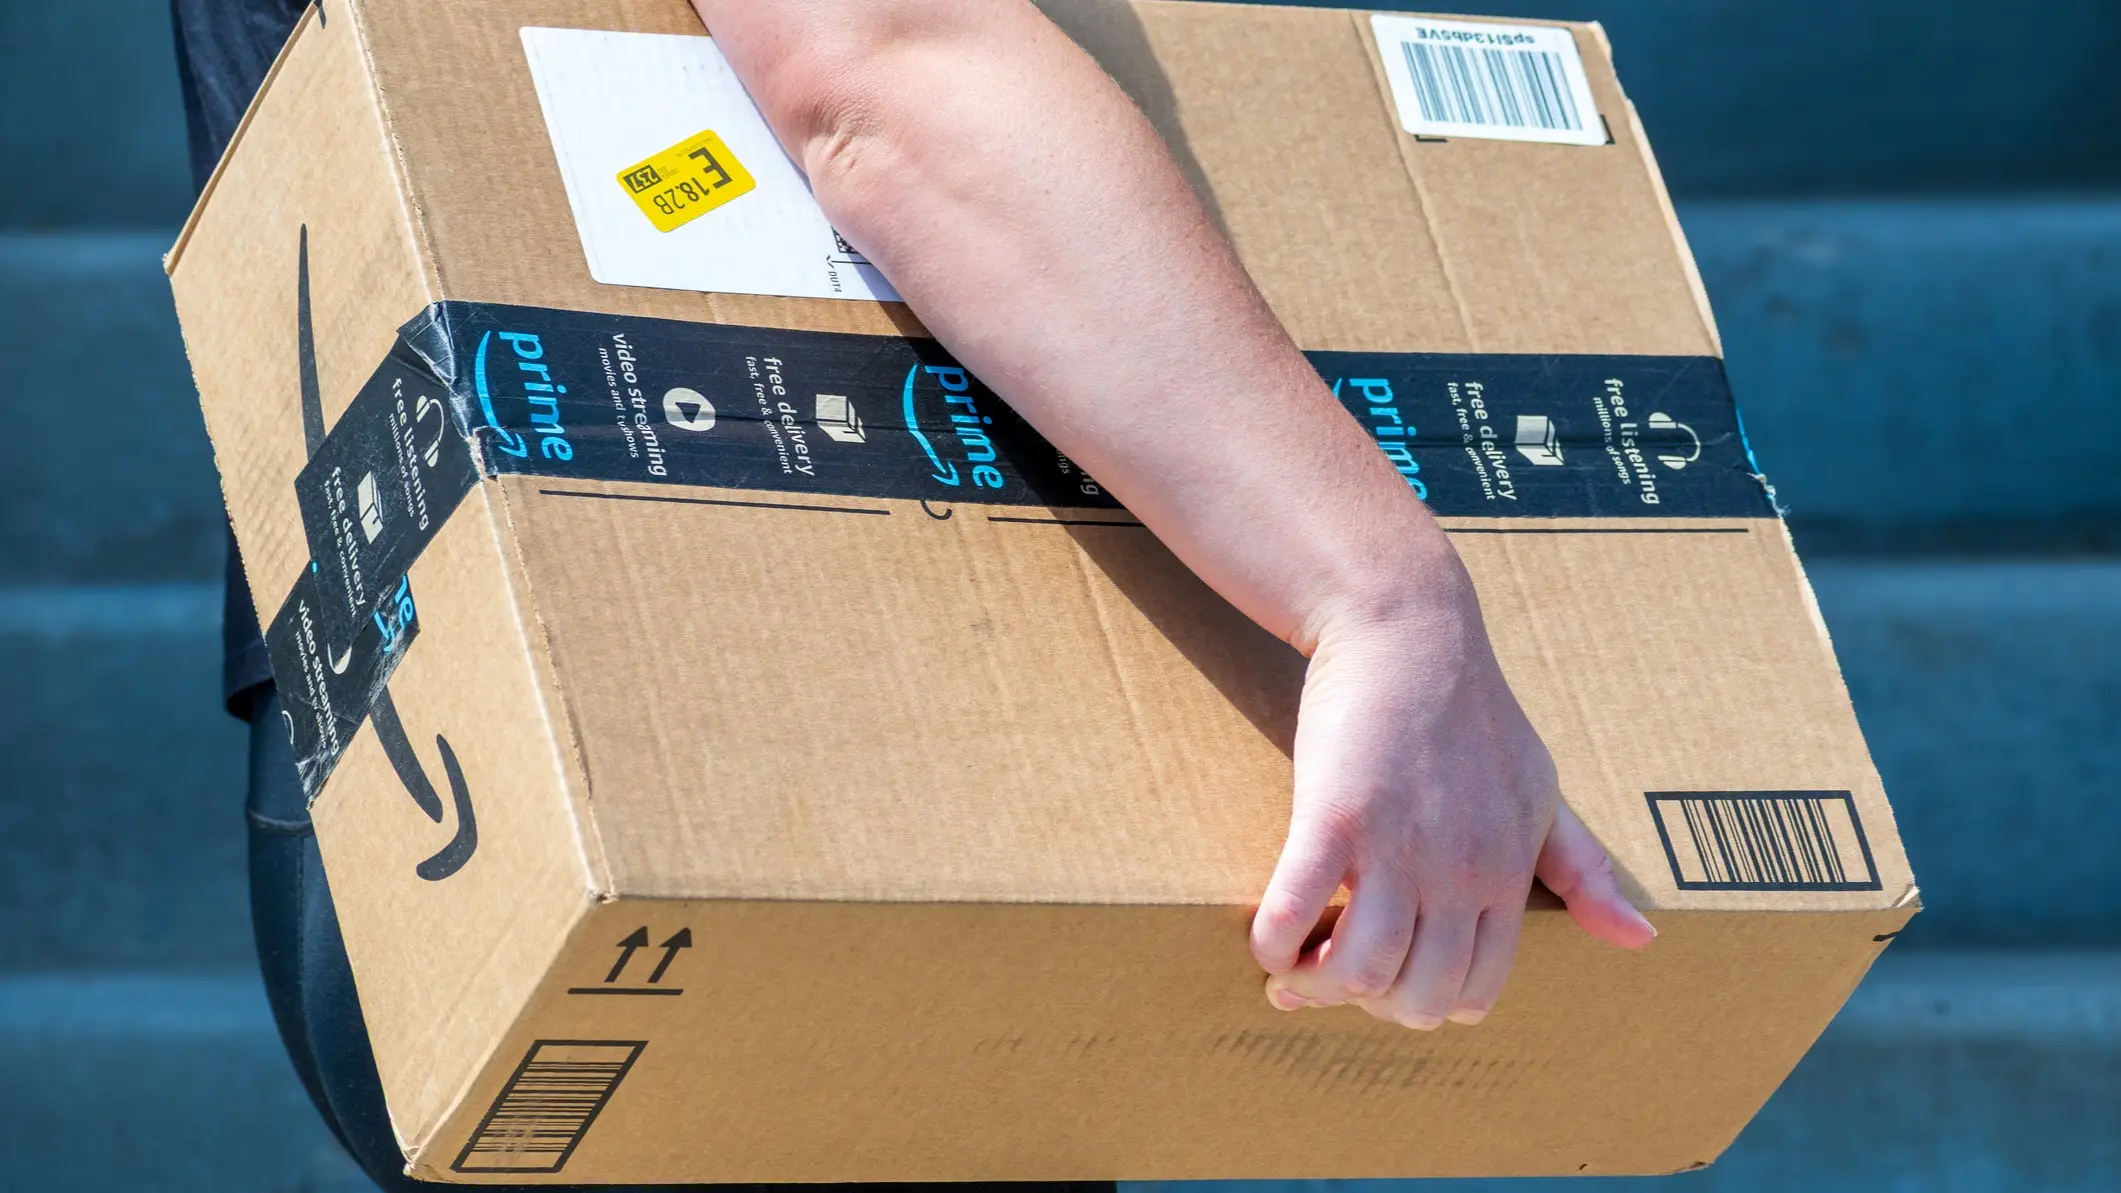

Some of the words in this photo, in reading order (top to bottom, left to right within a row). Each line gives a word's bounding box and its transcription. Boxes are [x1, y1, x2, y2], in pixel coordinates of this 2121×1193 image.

[629, 167, 659, 191] 237
[687, 147, 734, 189] E
[653, 177, 710, 215] 18.2B
[598, 347, 617, 387] movies
[611, 389, 626, 411] and
[745, 356, 760, 379] fast,
[753, 383, 767, 405] free
[499, 331, 573, 461] prime
[613, 333, 637, 384] video
[628, 387, 667, 476] streaming
[761, 407, 772, 416] &
[763, 357, 786, 396] free
[777, 402, 815, 476] delivery
[1592, 397, 1612, 443] millions
[389, 413, 404, 464] millions
[764, 420, 793, 474] convenient
[924, 365, 1005, 489] prime
[1447, 382, 1462, 406] fast,
[1456, 408, 1470, 430] free
[1465, 447, 1496, 500] convenient
[1464, 381, 1488, 420] free
[1480, 425, 1517, 500] delivery
[1604, 378, 1628, 417] free
[1620, 423, 1660, 504] listening
[1606, 446, 1620, 455] of
[392, 378, 407, 426] free
[404, 427, 429, 531] listening
[401, 465, 409, 478] of
[1612, 456, 1631, 485] songs
[404, 481, 414, 517] songs
[332, 467, 346, 514] free
[343, 518, 366, 605] delivery
[295, 631, 309, 673] movies
[306, 673, 315, 697] and
[299, 600, 316, 654] video
[312, 655, 340, 756] streaming
